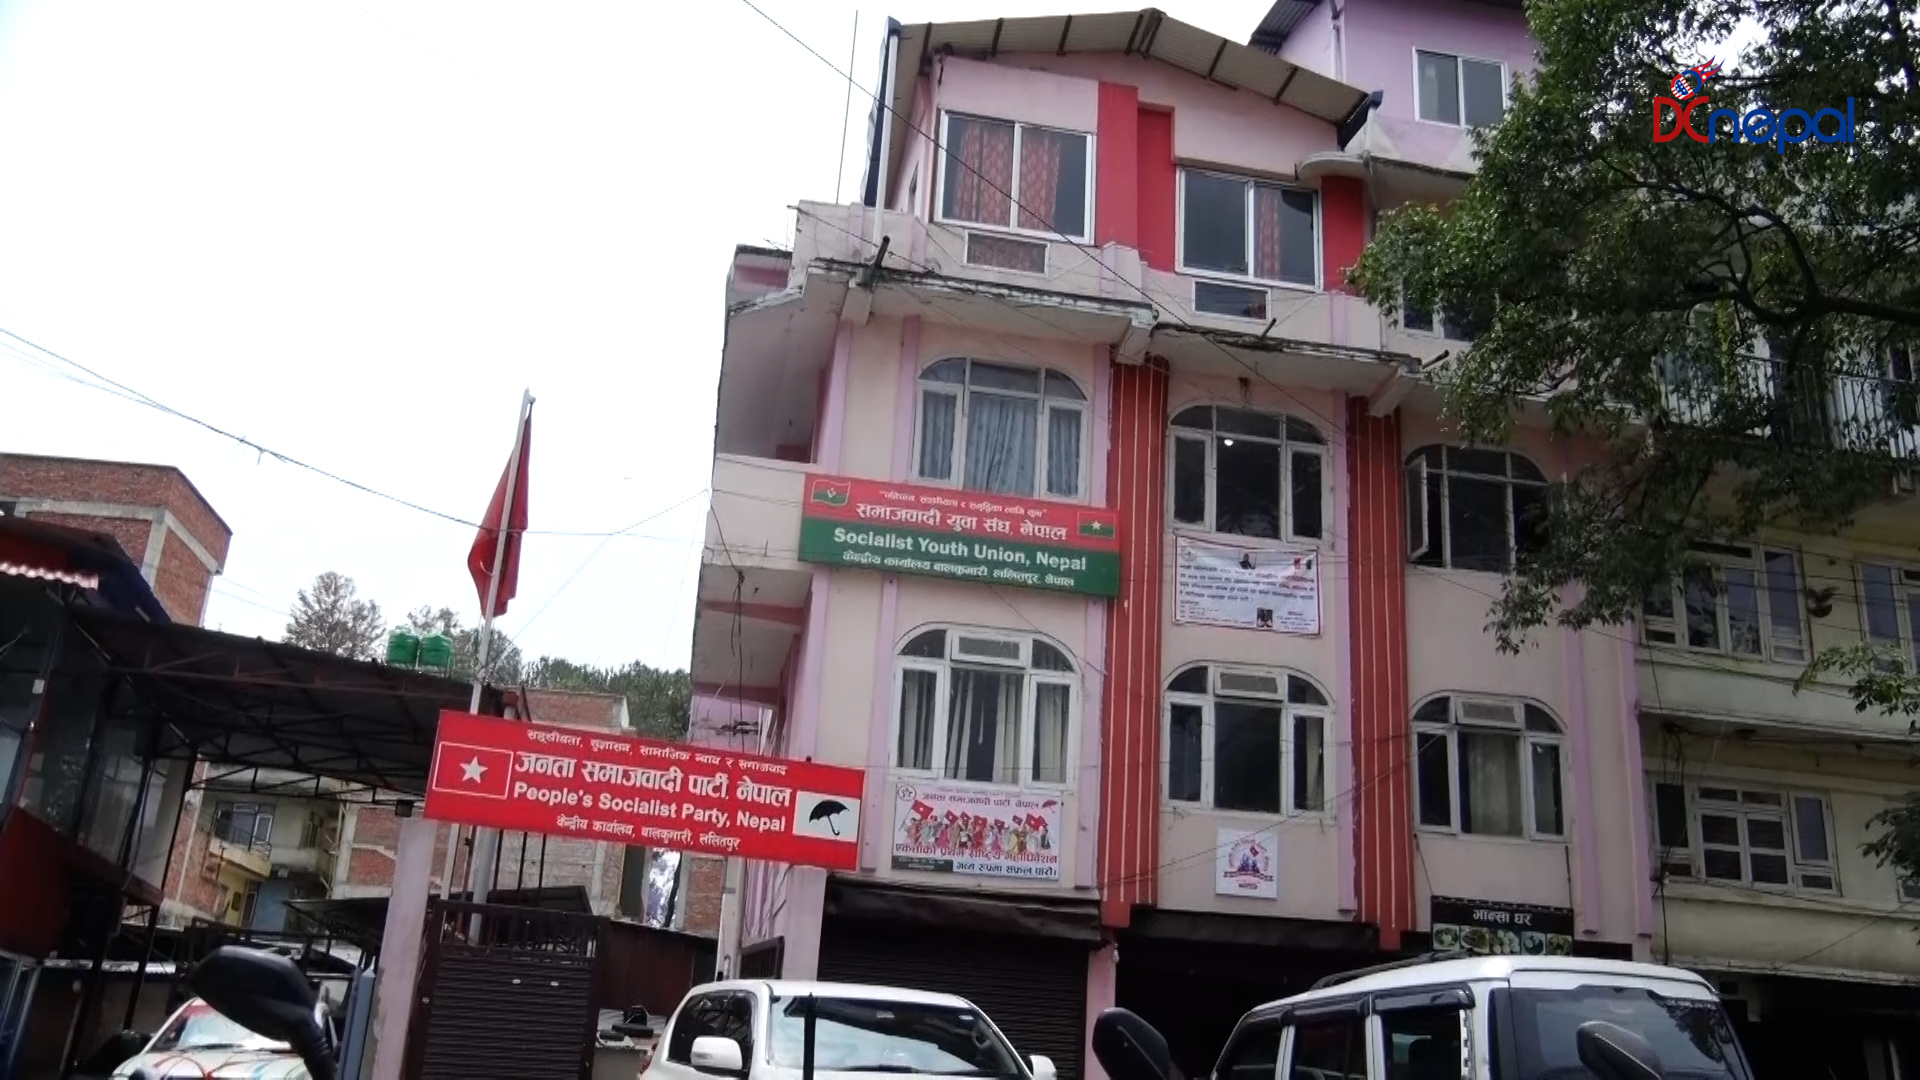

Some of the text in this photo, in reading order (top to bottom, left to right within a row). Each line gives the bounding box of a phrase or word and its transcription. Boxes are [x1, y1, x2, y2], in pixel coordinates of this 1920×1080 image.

[856, 502, 942, 526] समाजवादी
[946, 513, 978, 532] युवा
[1020, 519, 1069, 540] नेपाल
[834, 527, 1087, 572] Socialist Youth Union, Nepal
[515, 751, 577, 778] जनता
[581, 759, 684, 794] समाजवादी
[736, 775, 793, 807] नेपाल
[640, 745, 691, 762] सामाजिक
[695, 752, 721, 765] न्याय
[726, 757, 734, 768] र
[738, 758, 789, 776] समाजवाद
[513, 781, 786, 833] People's Socialist Party, Nepal
[699, 833, 741, 851] ललितपुर
[1514, 913, 1533, 926] घर
